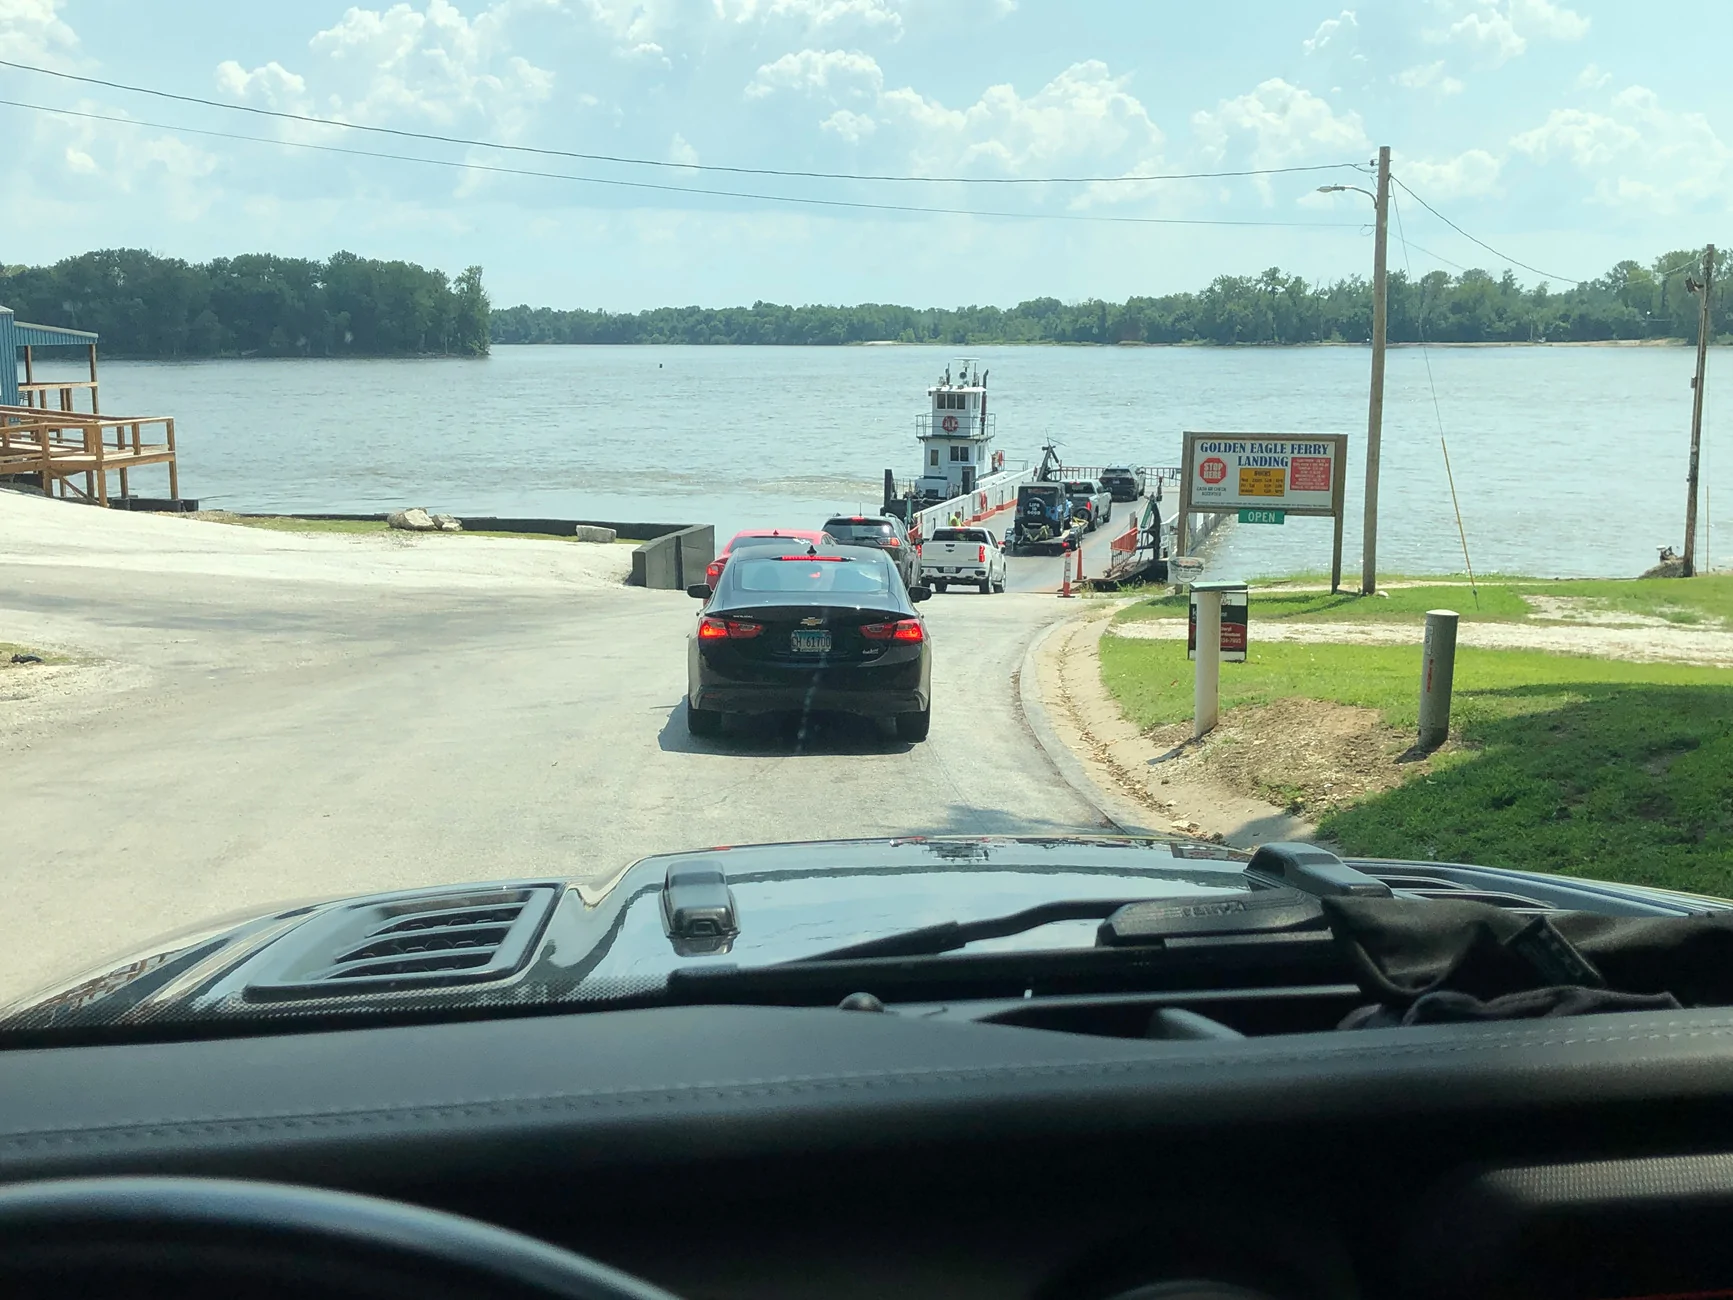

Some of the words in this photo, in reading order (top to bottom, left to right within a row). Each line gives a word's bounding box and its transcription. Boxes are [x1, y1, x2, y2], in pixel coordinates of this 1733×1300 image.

[1200, 442, 1247, 454] GOLDEN
[1250, 442, 1287, 454] EAGLE
[1290, 443, 1330, 455] FERRY
[1203, 462, 1224, 471] STOP
[1238, 455, 1289, 467] LANDING
[1203, 471, 1222, 479] HERE
[1248, 511, 1276, 523] OPEN
[806, 636, 831, 648] 61700
